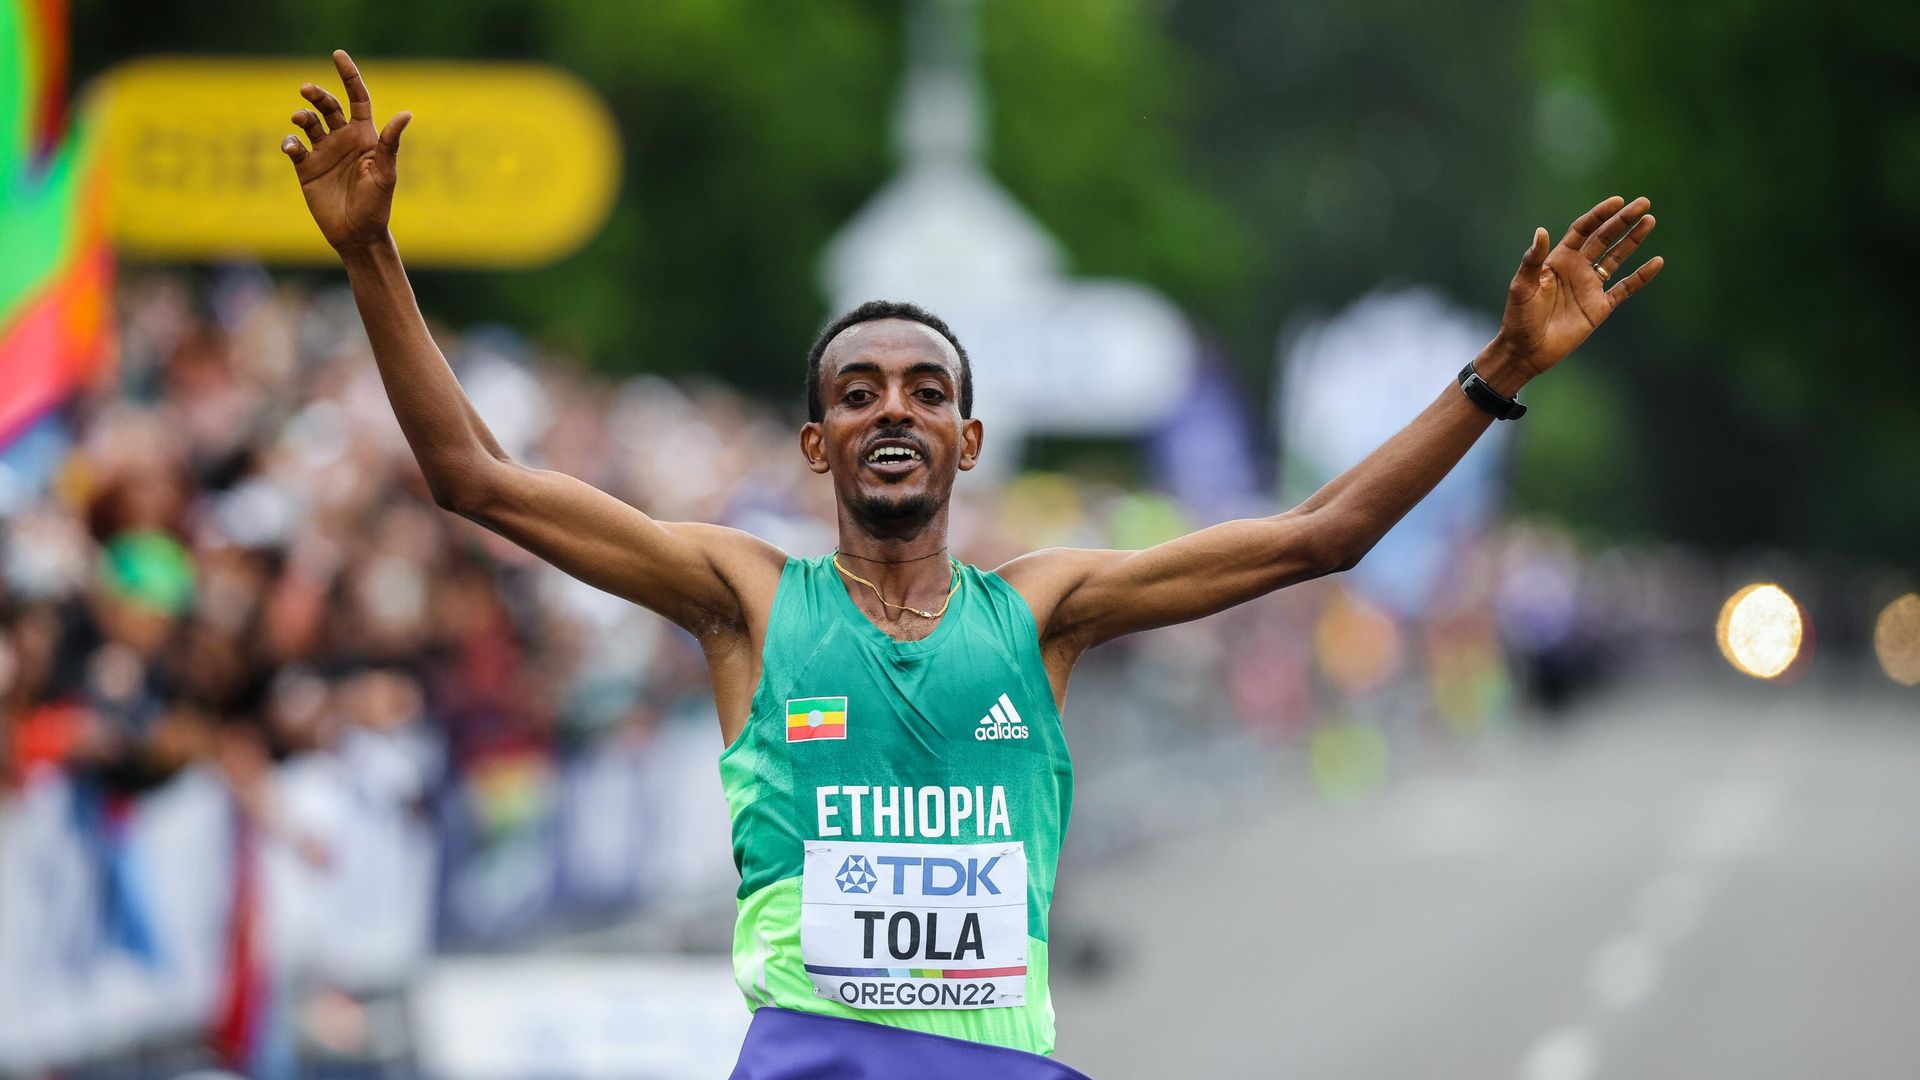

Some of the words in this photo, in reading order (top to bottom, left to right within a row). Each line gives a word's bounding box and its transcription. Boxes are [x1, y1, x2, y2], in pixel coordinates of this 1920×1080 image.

[975, 723, 1029, 740] adidas
[816, 785, 1012, 837] ETHIOPIA
[877, 856, 1002, 896] TDK
[854, 911, 985, 961] TOLA
[839, 982, 996, 1005] OREGON22
